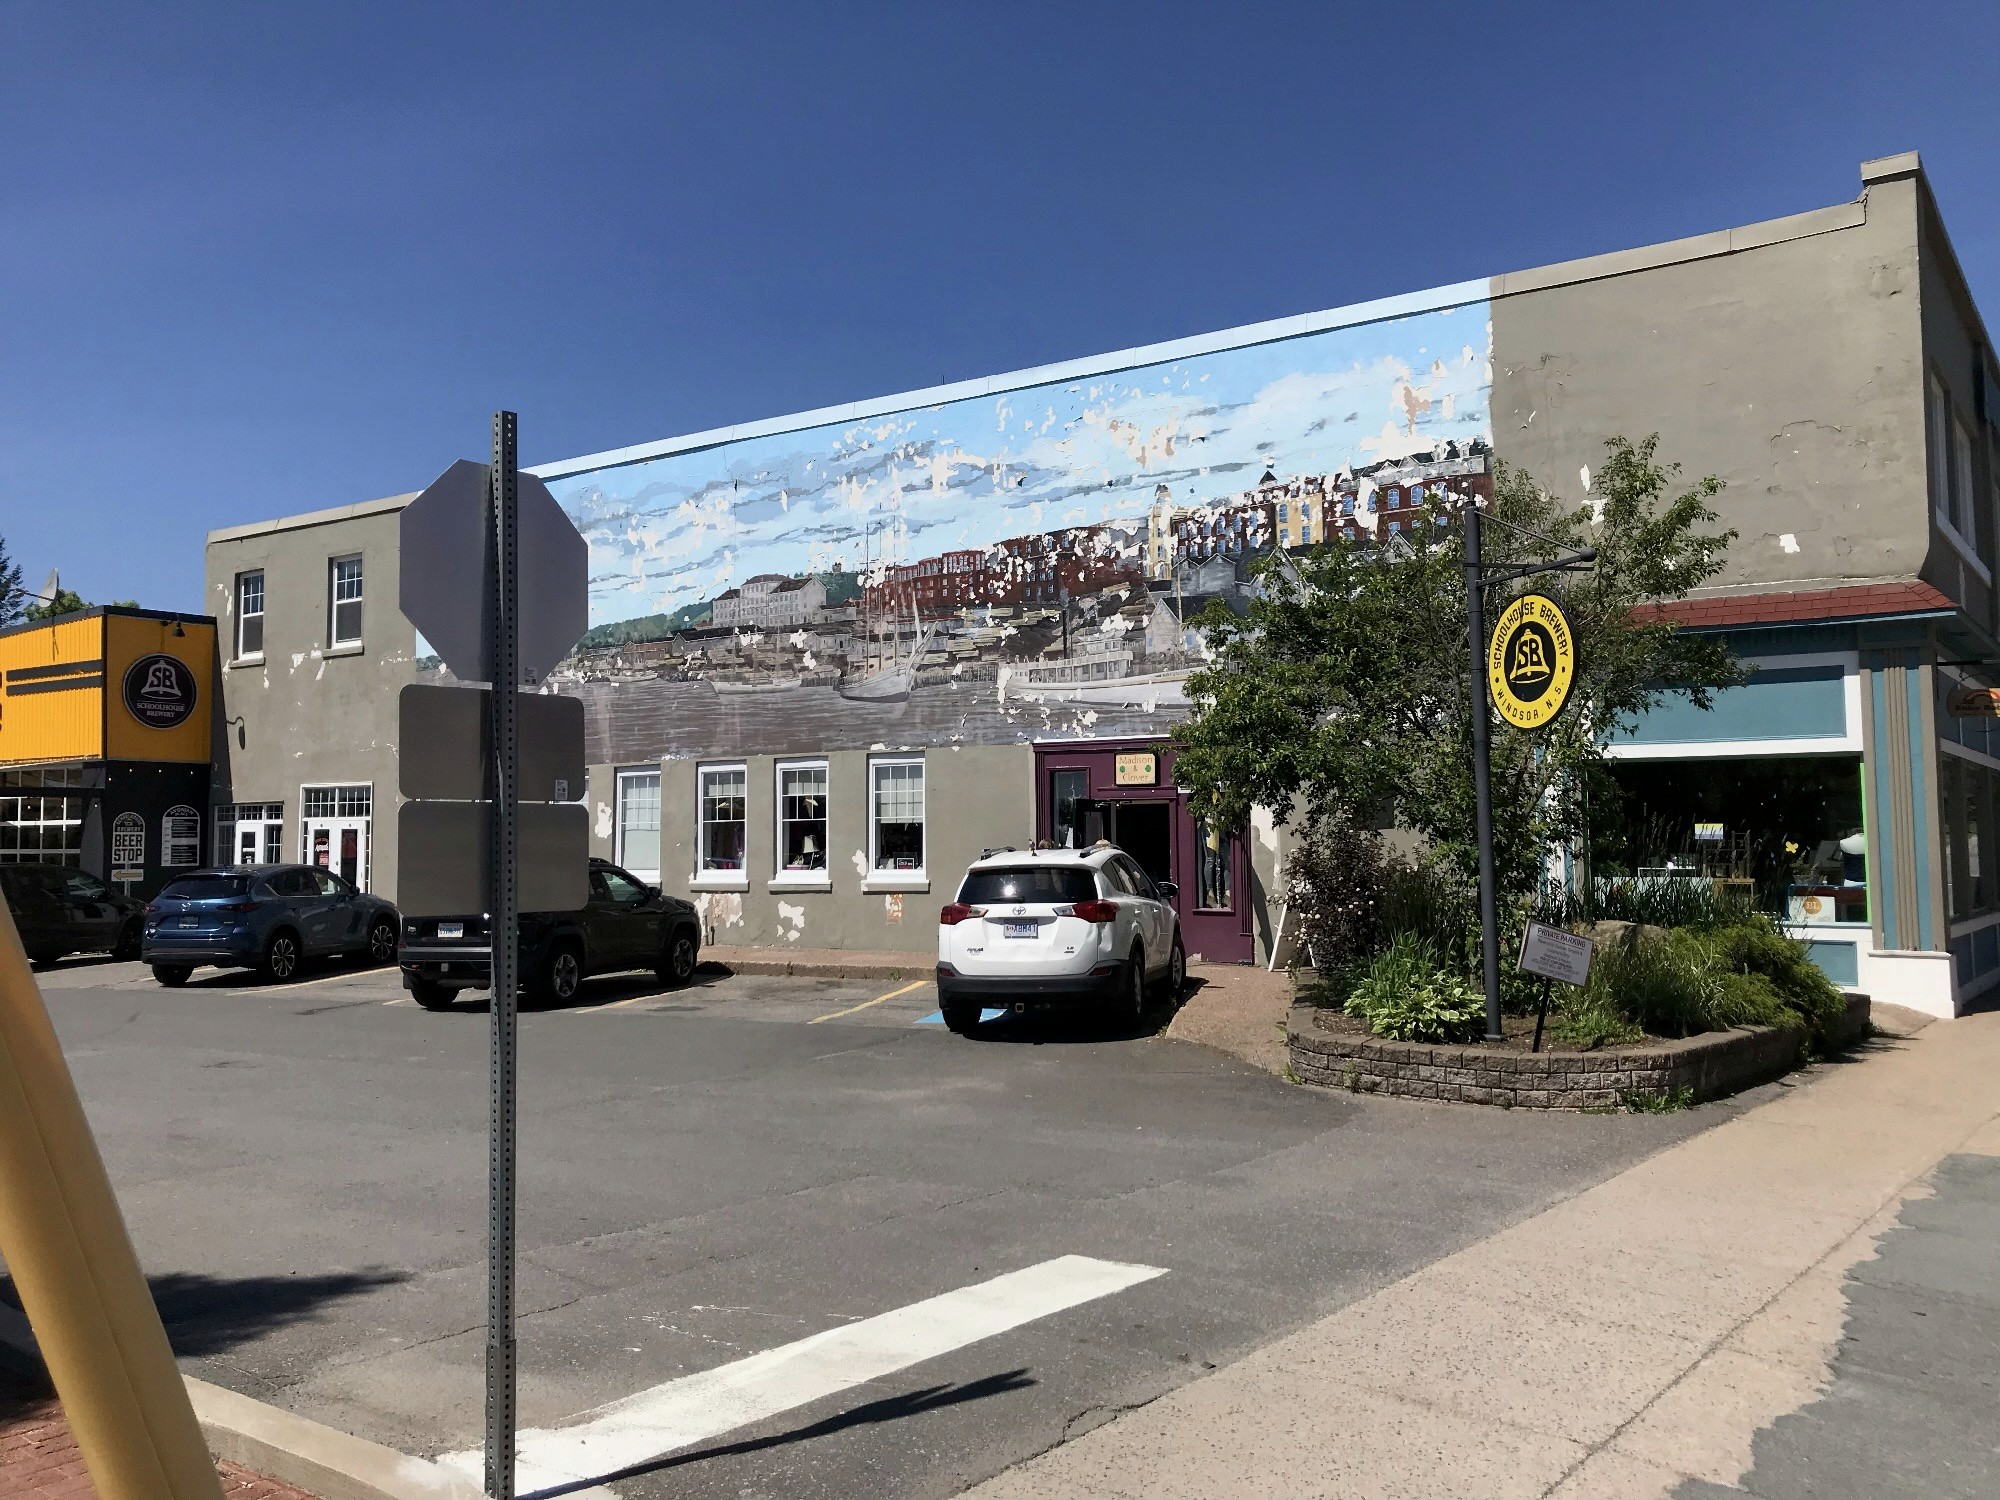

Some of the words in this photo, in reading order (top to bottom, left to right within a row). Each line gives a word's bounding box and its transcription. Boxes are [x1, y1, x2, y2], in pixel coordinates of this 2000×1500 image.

[1493, 601, 1535, 669] SCHOOLHOUSE
[1540, 604, 1568, 657] BREWERY
[1516, 637, 1543, 670] SB
[149, 666, 175, 690] SB
[137, 703, 185, 712] SCHOOLHOUSE
[146, 710, 175, 718] BREWERY
[1118, 756, 1153, 764] Madison
[1122, 773, 1149, 782] Clover
[114, 833, 143, 847] BEER
[113, 848, 142, 862] STOP
[1537, 927, 1560, 940] PRIVATE
[1560, 934, 1586, 948] PARKING
